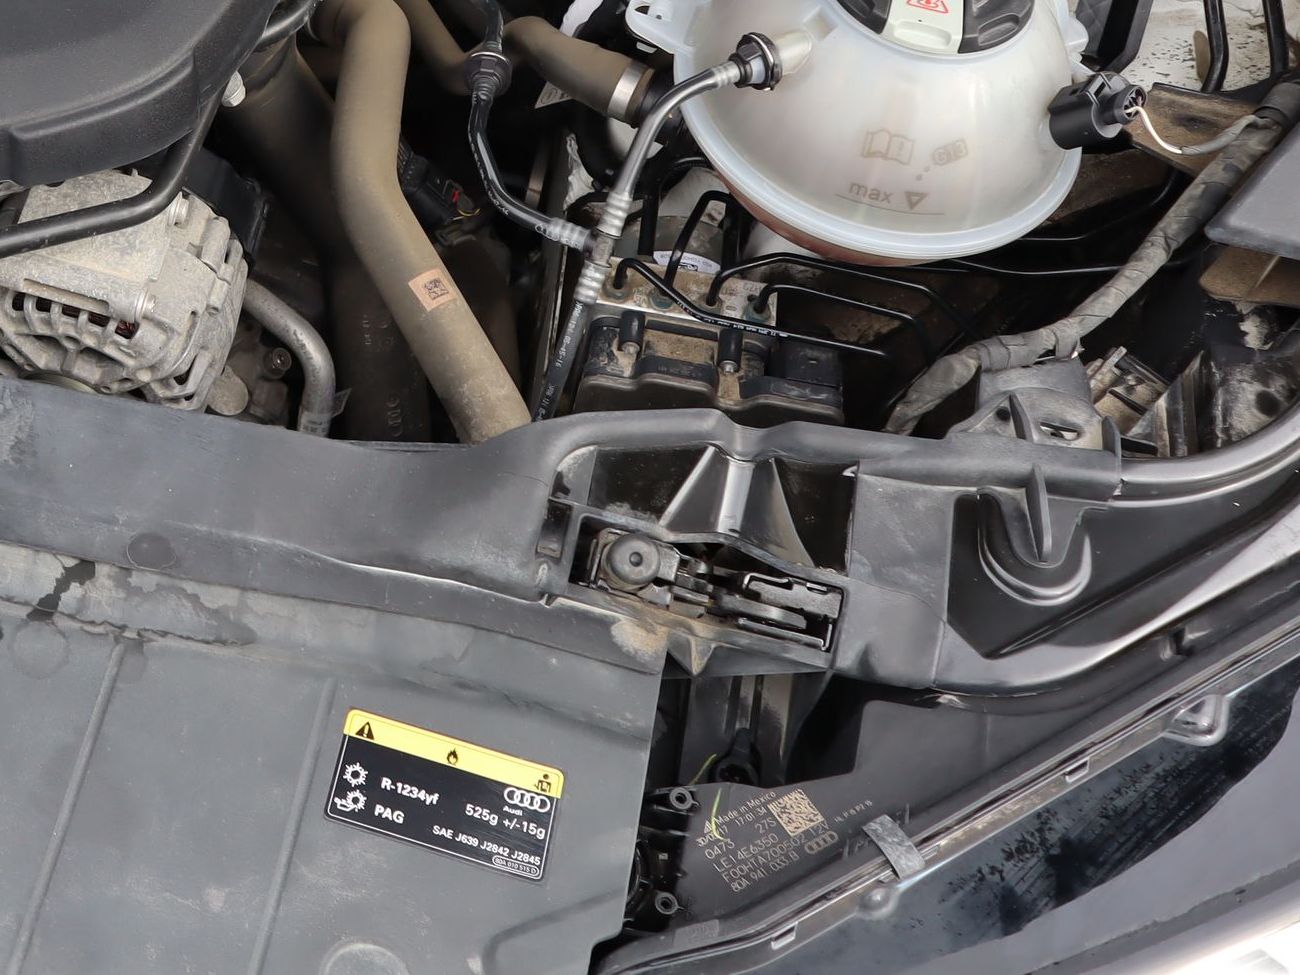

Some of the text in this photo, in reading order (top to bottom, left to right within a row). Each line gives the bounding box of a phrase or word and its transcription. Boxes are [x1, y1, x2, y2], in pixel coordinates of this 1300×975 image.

[848, 181, 893, 203] max
[374, 804, 405, 824] PAG
[381, 776, 546, 839] R-1234yf 525g +/-15g
[503, 805, 523, 816] Audi
[714, 788, 777, 826] Made in Mexico
[433, 825, 541, 866] SAE J639 J2842 J2845
[703, 816, 777, 861] 0473 27S
[720, 820, 830, 884] F00HTA700502 12V
